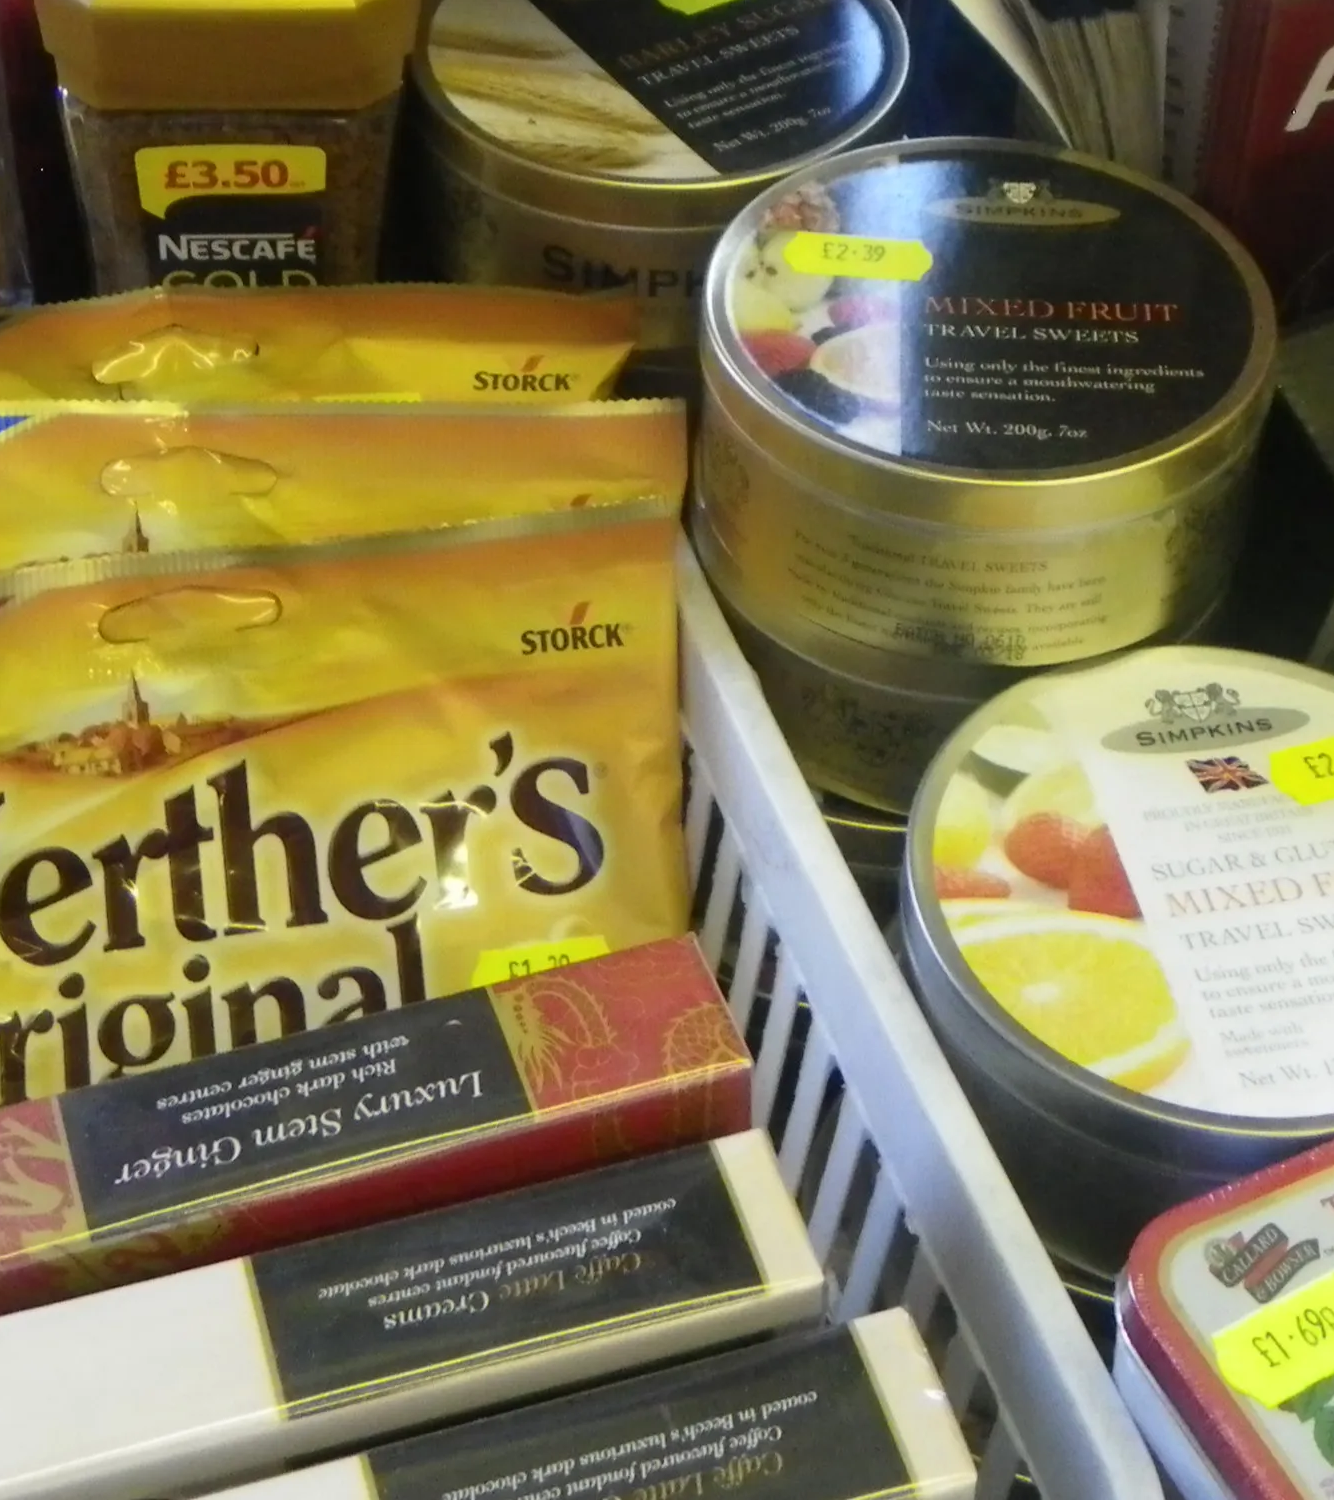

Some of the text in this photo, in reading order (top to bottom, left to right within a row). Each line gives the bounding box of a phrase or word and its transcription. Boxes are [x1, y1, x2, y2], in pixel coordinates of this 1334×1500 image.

[638, 24, 800, 87] TRAVEL SWEETS
[163, 159, 289, 190] £3.50
[924, 296, 1180, 323] MIXED FRUIT
[923, 323, 1140, 344] TRAVEL SWEETS
[472, 369, 573, 393] STORCK
[924, 356, 1205, 382] Using only the finest ingredients
[519, 620, 627, 656] STORCK
[1135, 717, 1274, 748] SIMPKINS
[1150, 851, 1244, 882] SUGAR
[1249, 850, 1268, 869] &
[1164, 875, 1304, 919] MIXED
[1179, 920, 1294, 951] TRAVEL
[156, 1033, 410, 1110] with stem ginger centres
[181, 1057, 397, 1126] Rich dark chocolates
[114, 1068, 485, 1187] Luxury Stem Ginger
[440, 1390, 818, 1499] coated in Beech's luxurious dark chocolate
